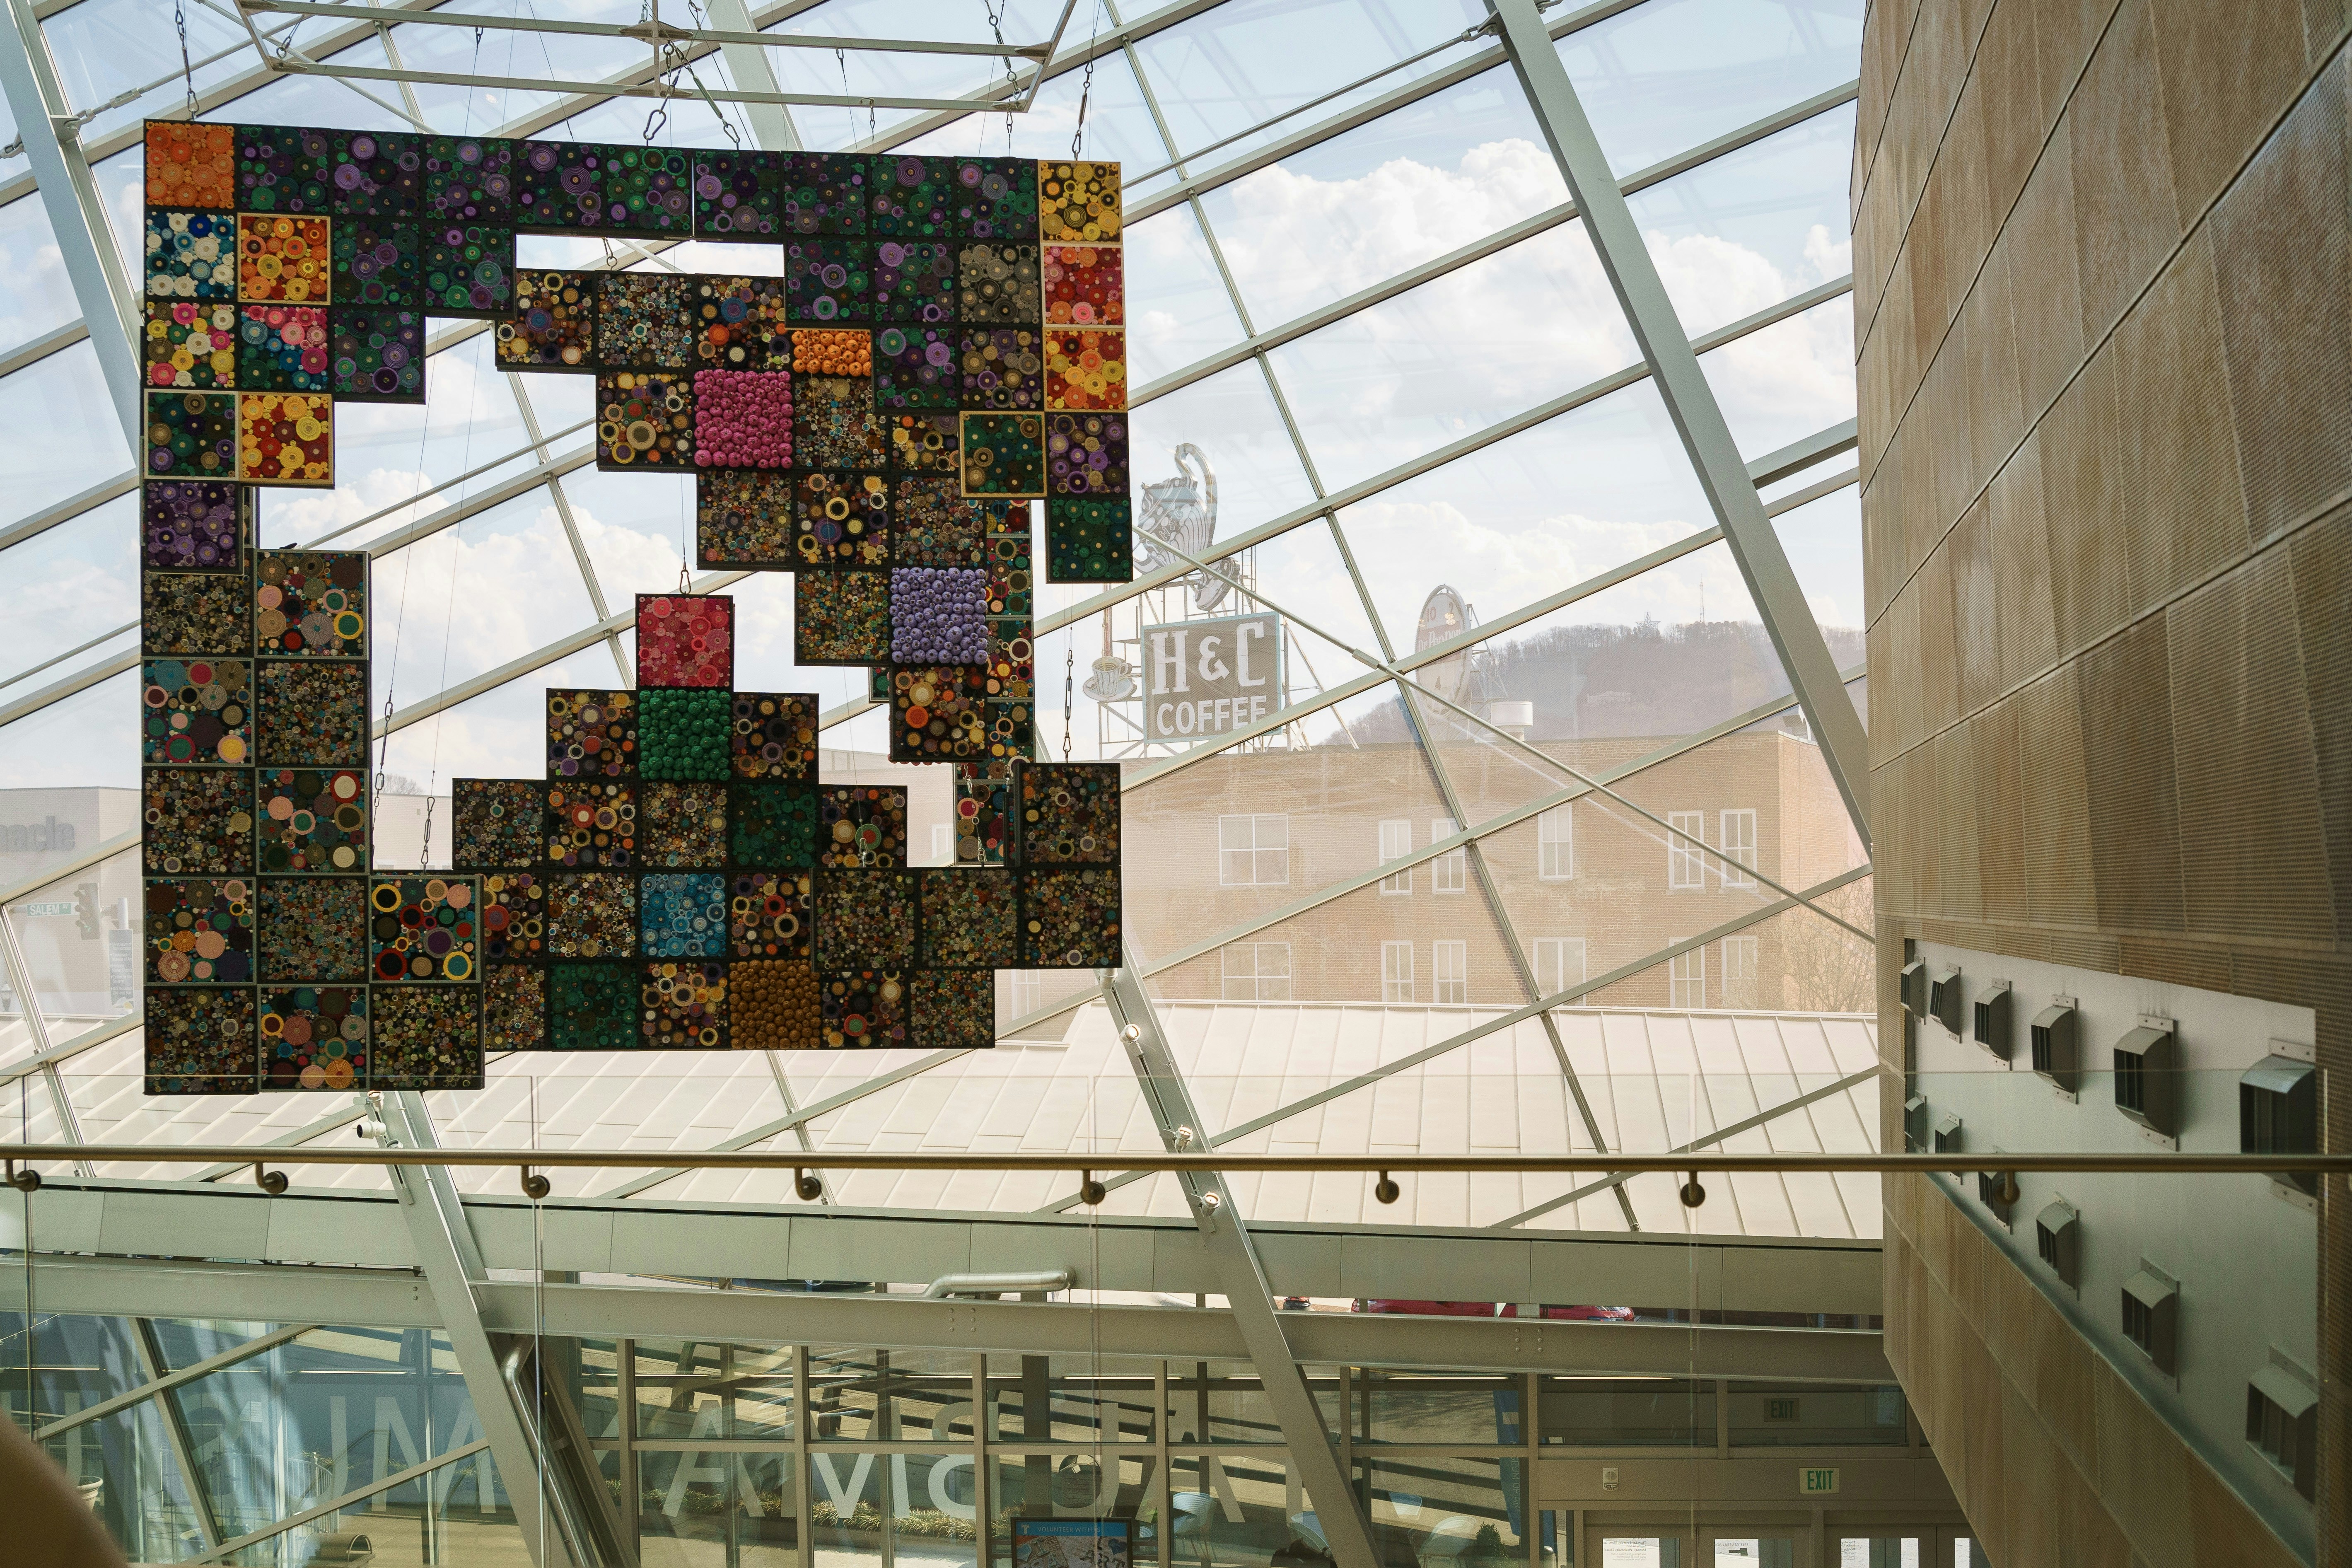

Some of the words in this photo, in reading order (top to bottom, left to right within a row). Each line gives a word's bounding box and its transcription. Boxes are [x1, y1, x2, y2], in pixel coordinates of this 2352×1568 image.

[1156, 695, 1267, 735] COFFEE
[30, 904, 60, 915] SALEM
[1771, 1400, 1794, 1418] EXIT
[1807, 1470, 1834, 1490] EXIT
